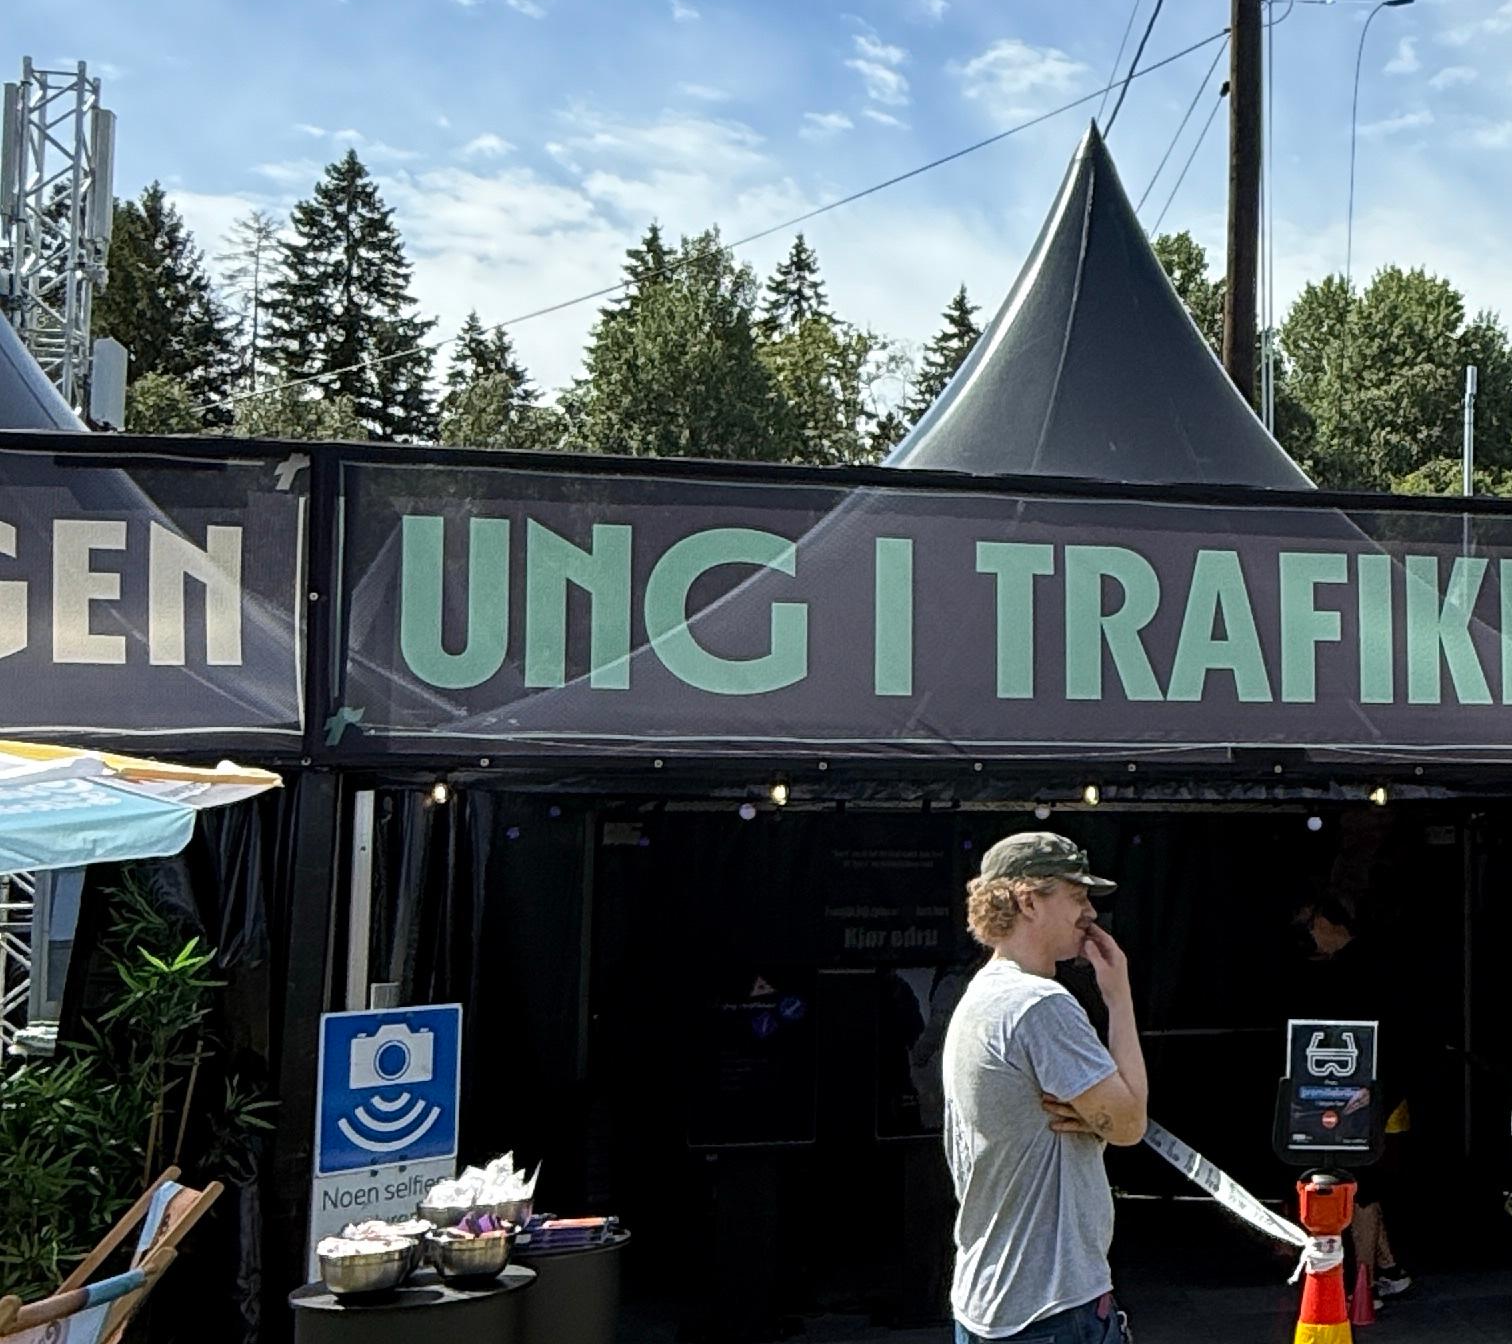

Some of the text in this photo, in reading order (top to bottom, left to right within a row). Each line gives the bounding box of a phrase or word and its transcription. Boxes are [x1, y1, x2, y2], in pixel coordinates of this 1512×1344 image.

[0, 518, 243, 666] EN
[400, 514, 809, 696] UNG
[874, 537, 913, 697] I
[322, 1186, 379, 1211] Noen
